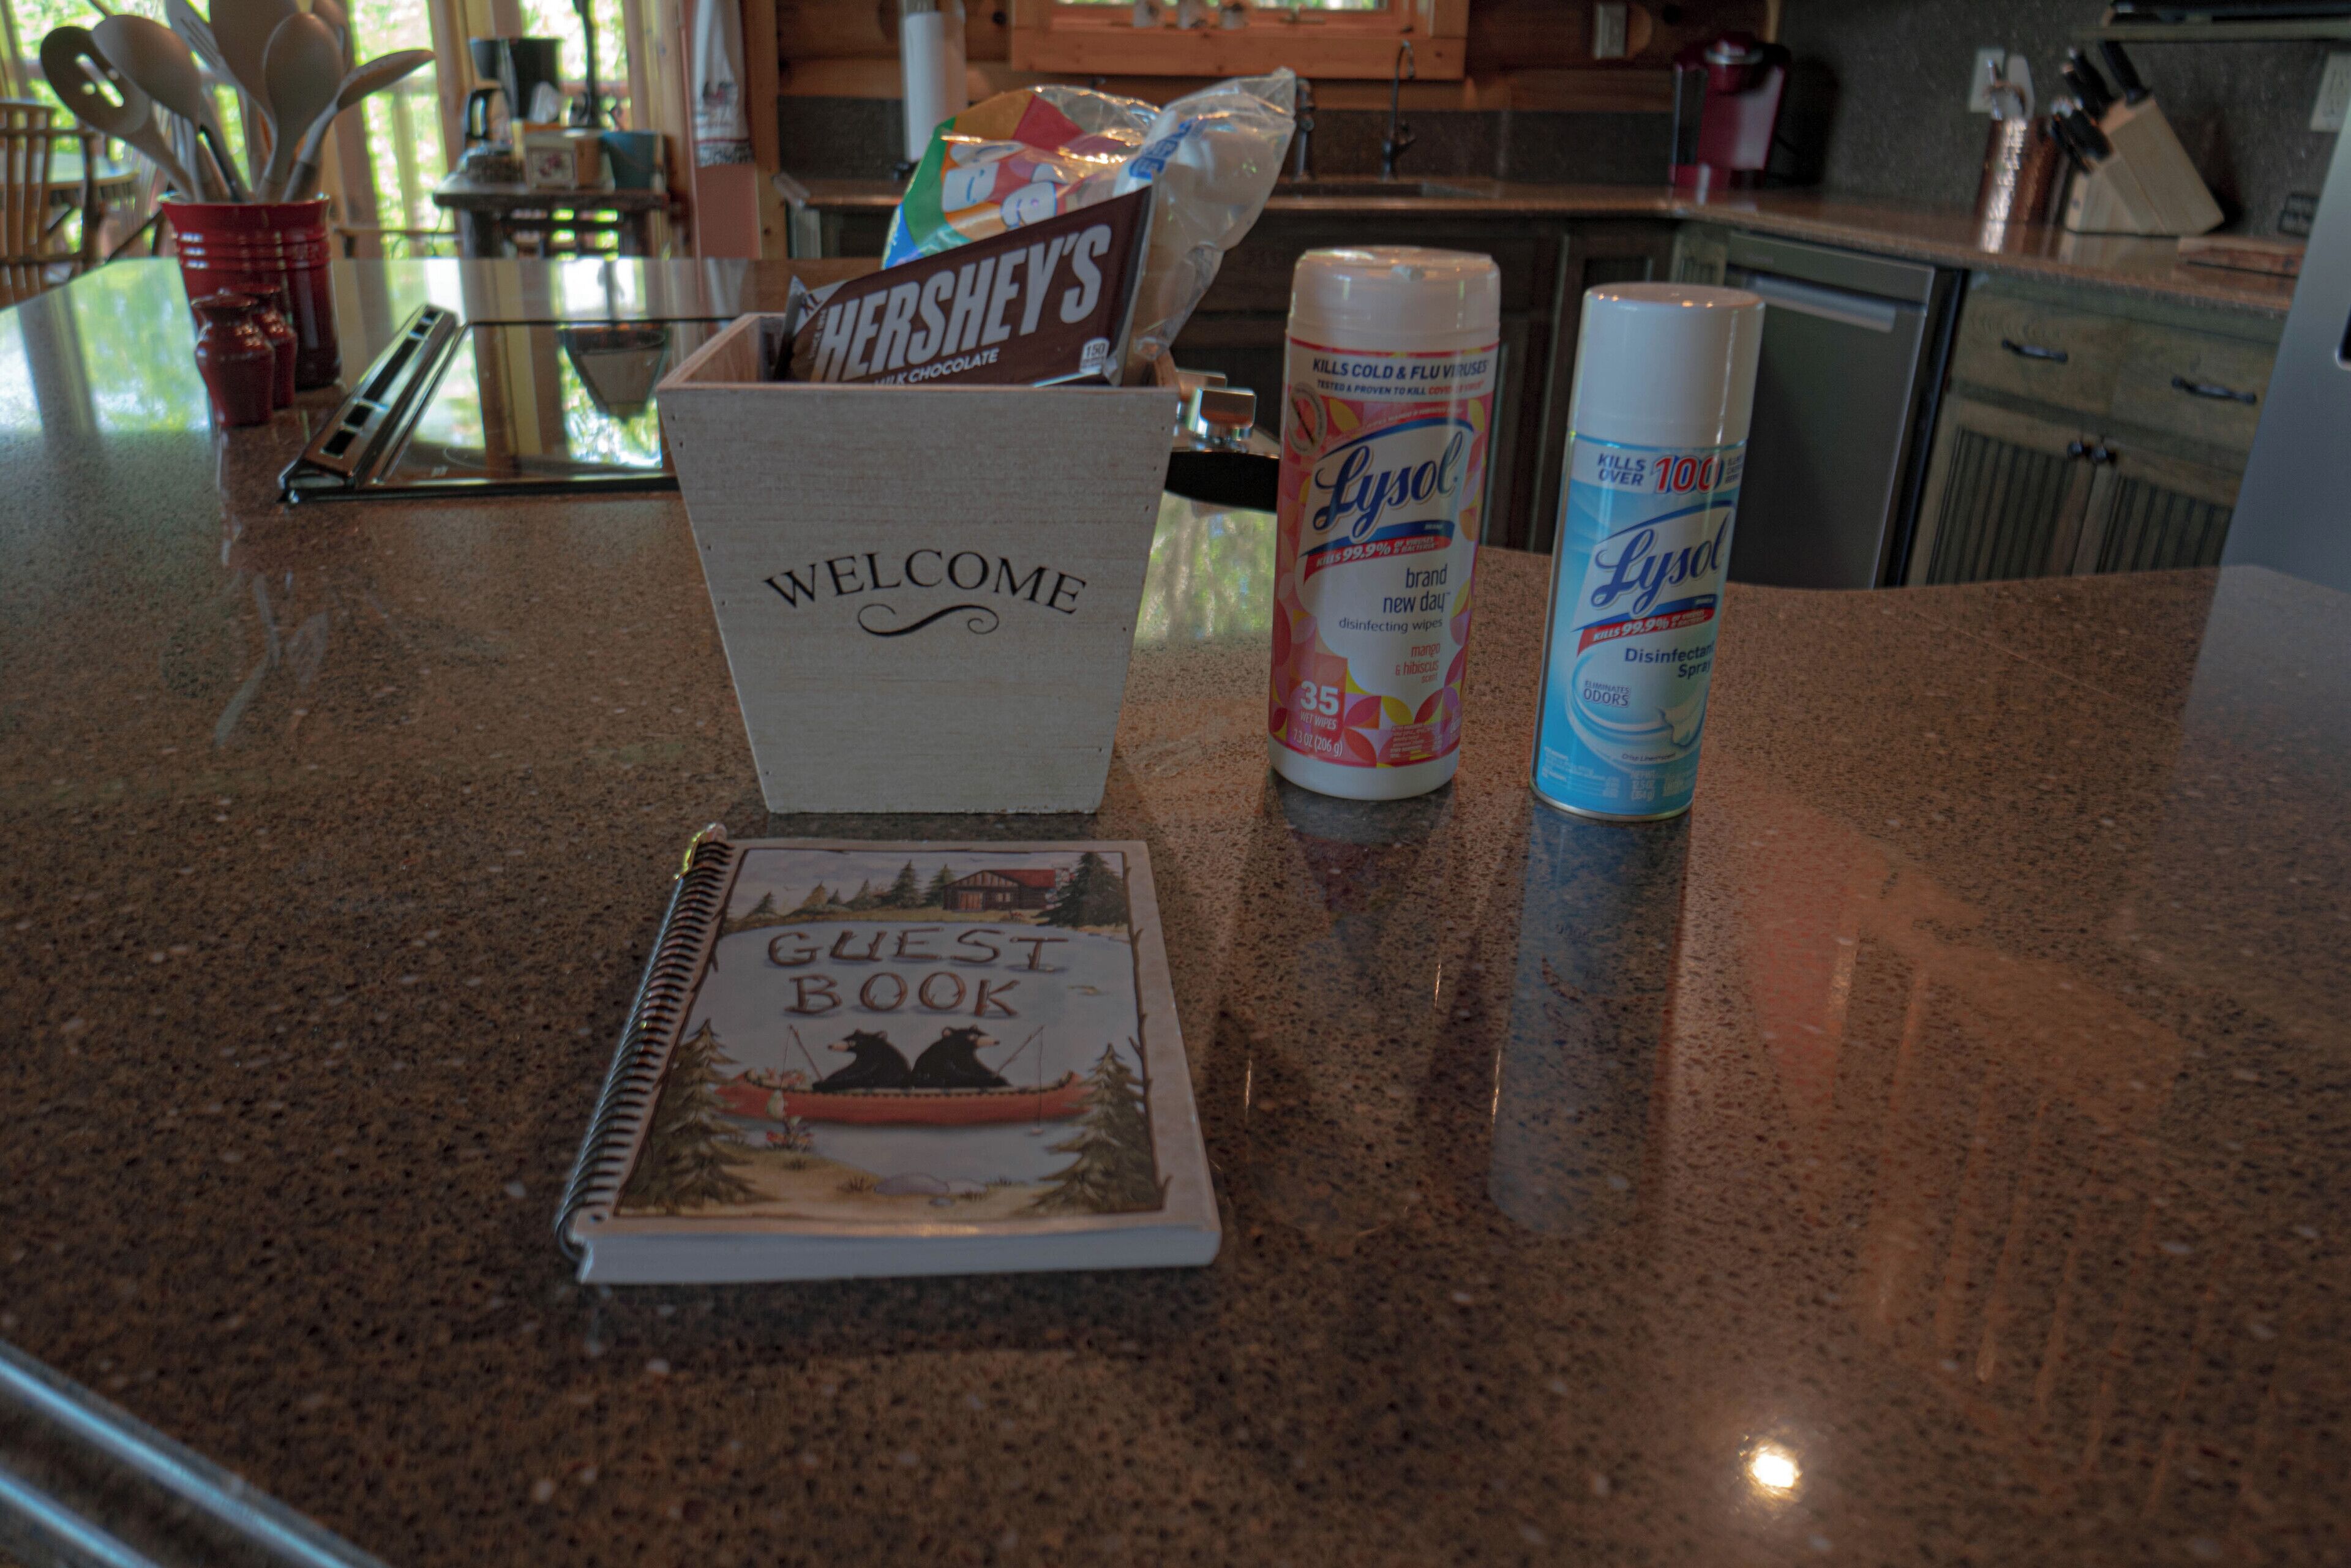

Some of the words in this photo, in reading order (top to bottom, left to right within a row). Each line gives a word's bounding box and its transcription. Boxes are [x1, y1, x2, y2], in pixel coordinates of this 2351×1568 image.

[801, 293, 819, 317] XL
[809, 223, 1112, 383] HERSHEY'S
[1087, 343, 1106, 358] 150
[908, 347, 1000, 383] CHOCOLATE
[1313, 358, 1348, 376] KILLS
[1351, 363, 1393, 378] COLD
[1397, 365, 1406, 380] &
[1410, 365, 1440, 380] FLU
[1317, 379, 1345, 391] TESTED
[1354, 384, 1390, 395] PROVEN
[1393, 386, 1406, 395] TO
[1407, 386, 1426, 396] KILL
[1313, 430, 1463, 538] Lysol
[1597, 453, 1646, 472] KILLS
[1654, 455, 1723, 493] 100
[1598, 471, 1644, 487] OVER
[1316, 553, 1341, 568] KILLS
[1342, 542, 1391, 562] 99.9%
[1591, 512, 1729, 615] Lysol
[764, 549, 1087, 615] WELCOME
[1405, 562, 1447, 588] brand
[1383, 598, 1415, 613] new
[1420, 591, 1445, 614] day
[1338, 617, 1409, 634] disinfecting
[1412, 617, 1443, 632] wipes
[1593, 628, 1621, 642] KILLS
[1621, 616, 1670, 637] 99.9%
[1411, 642, 1441, 658] mango
[1403, 660, 1439, 675] hibiscus
[1421, 672, 1438, 684] scent
[1678, 658, 1712, 680] Spray
[1300, 680, 1340, 716] 35
[1583, 688, 1629, 707] ODORS
[1584, 680, 1631, 694] ELIMINATES
[1300, 710, 1313, 724] WET
[1314, 715, 1337, 730] WIPES
[1303, 733, 1313, 748] OZ
[1314, 735, 1332, 752] (206
[1333, 740, 1343, 757] g)
[767, 927, 1069, 971] GUEST
[784, 970, 1022, 1018] BOOK
